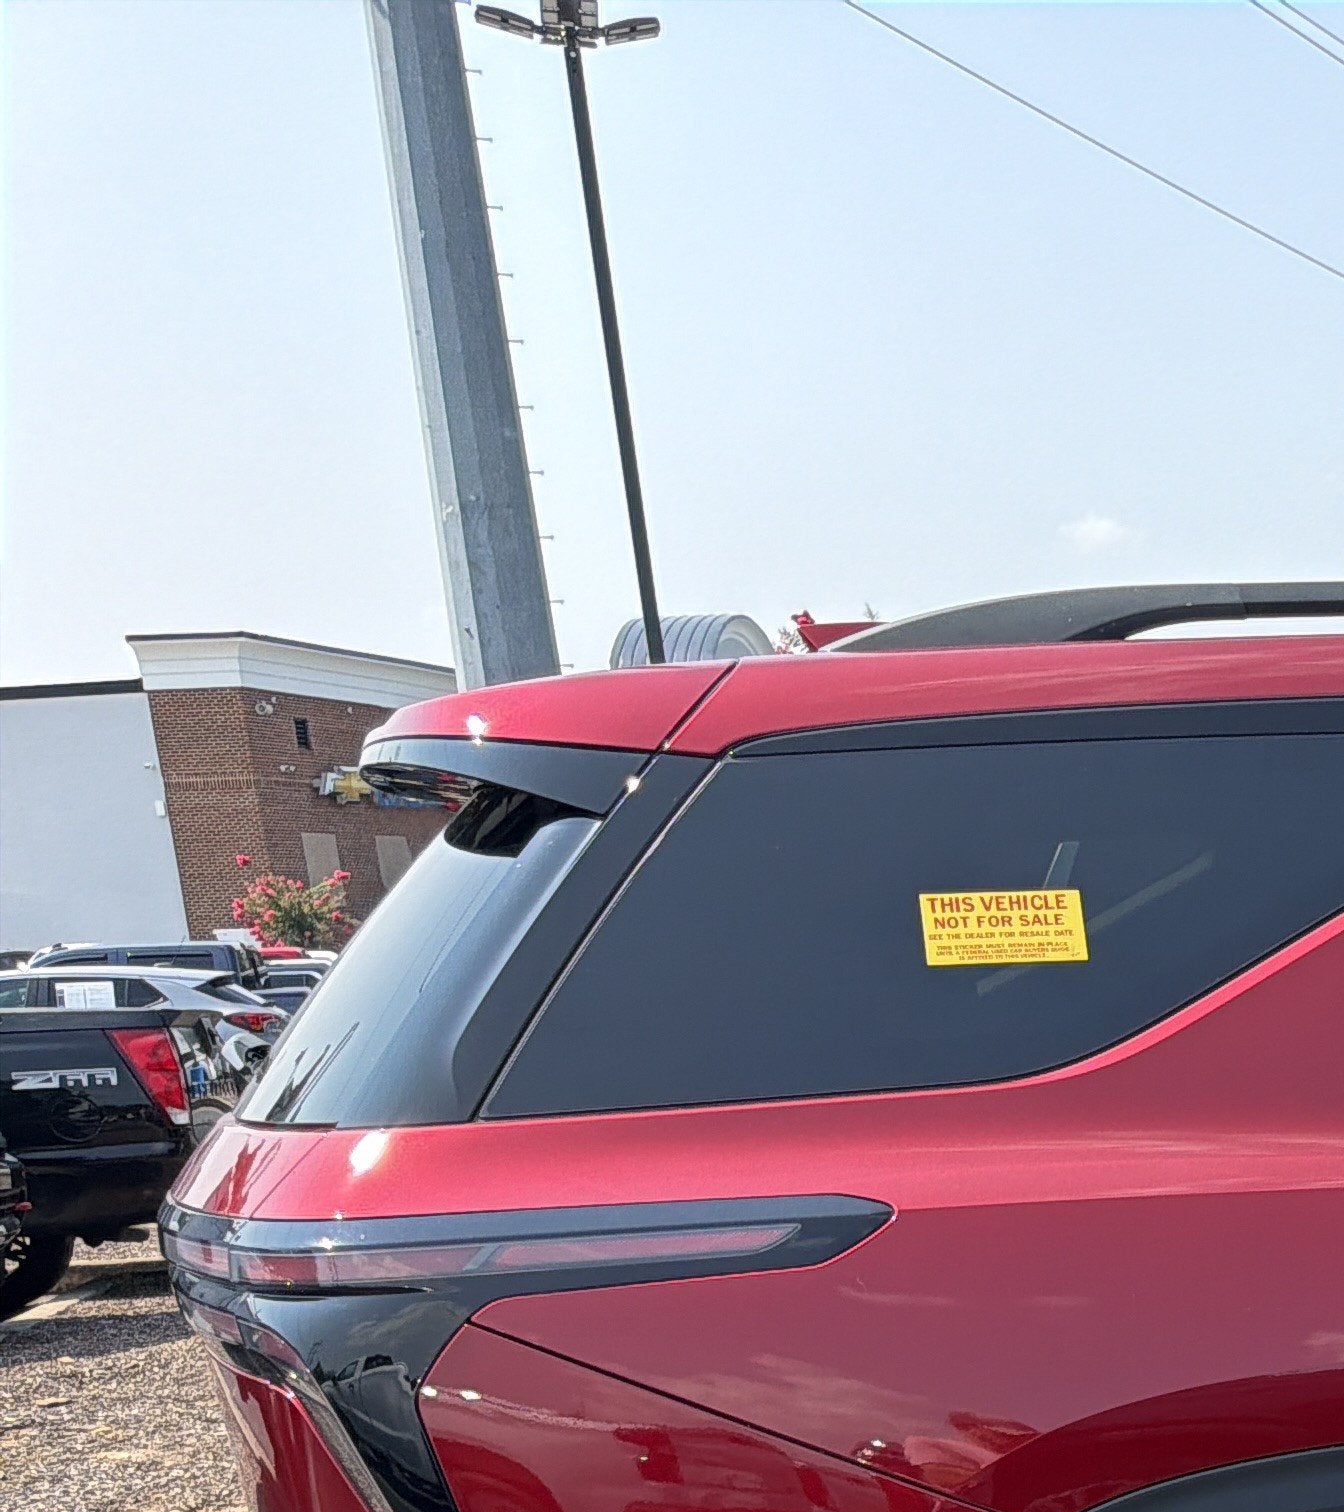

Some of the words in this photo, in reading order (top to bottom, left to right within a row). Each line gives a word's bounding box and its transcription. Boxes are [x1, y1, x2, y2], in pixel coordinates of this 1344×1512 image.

[926, 896, 975, 914] THIS
[979, 893, 1068, 912] VEHICLE
[933, 915, 970, 930] NOT
[976, 914, 1013, 929] FOR
[1019, 913, 1065, 927] SALE
[928, 933, 944, 941] SEE
[946, 932, 962, 940] THE
[965, 931, 996, 939] DEALER
[999, 930, 1016, 938] FOR
[1019, 929, 1050, 938] RESALE
